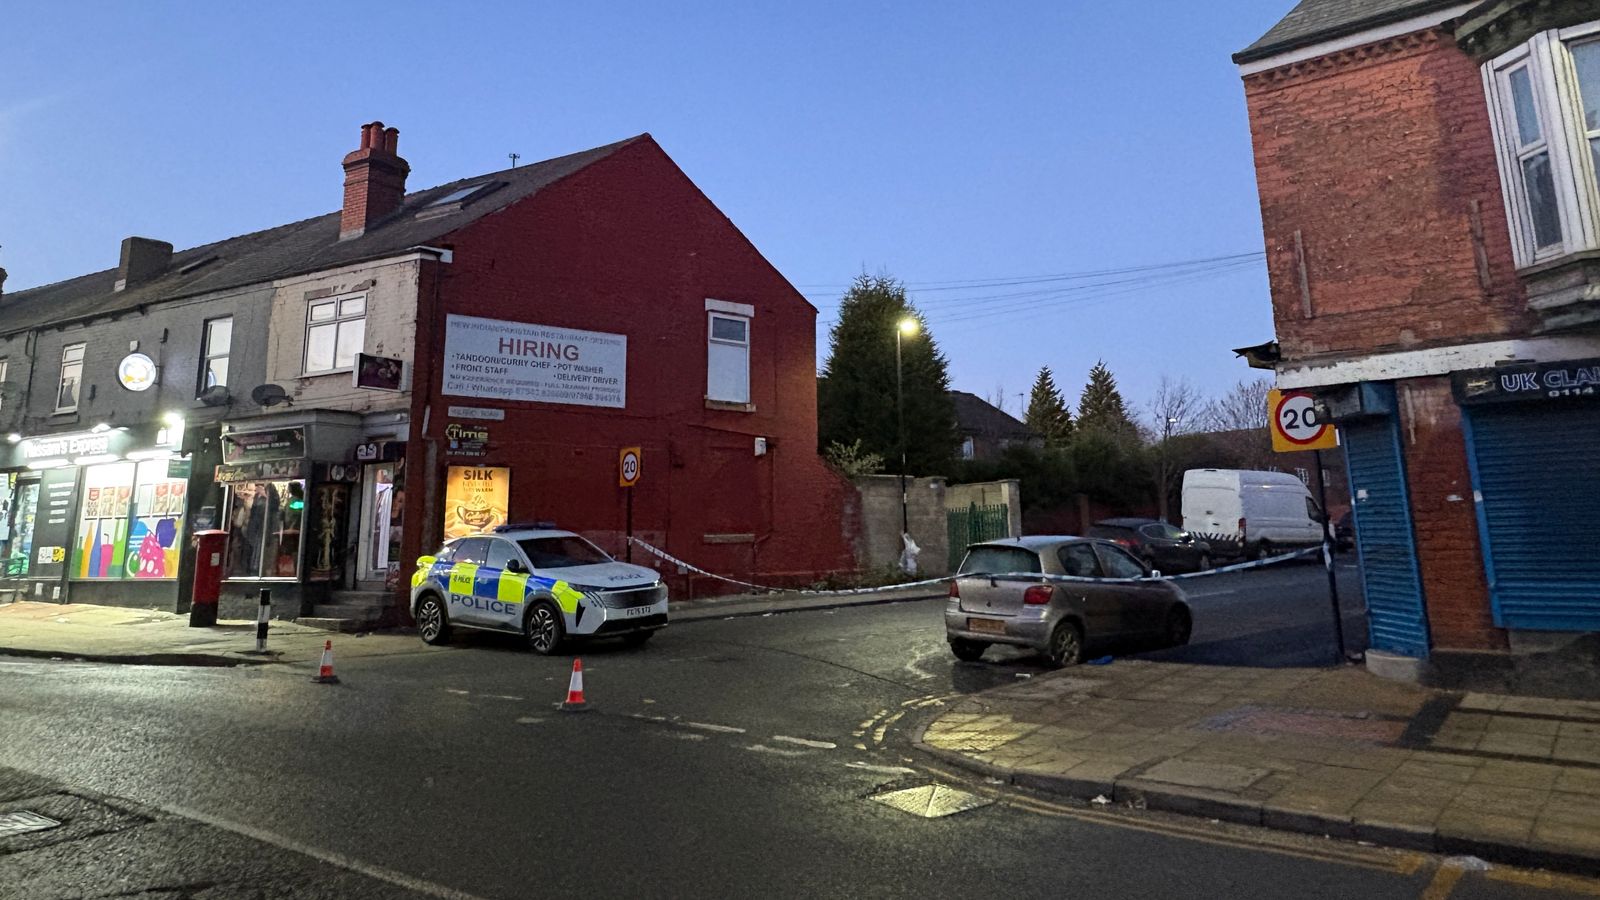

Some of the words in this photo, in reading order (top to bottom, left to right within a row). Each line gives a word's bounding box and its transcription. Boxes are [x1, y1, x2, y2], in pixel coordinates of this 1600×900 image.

[499, 337, 580, 361] HIRING
[455, 364, 483, 374] FRONT
[484, 366, 509, 375] STAFF
[530, 360, 552, 369] CHEF
[557, 363, 573, 372] POT
[574, 365, 604, 374] WASHER
[557, 373, 592, 383] DELIVERY
[593, 376, 618, 385] DRIVER
[1501, 372, 1540, 391] UK
[1548, 387, 1594, 397] 0114
[1283, 406, 1317, 430] 20
[624, 460, 636, 474] 20
[463, 469, 493, 481] SILK
[450, 594, 516, 616] POLICE
